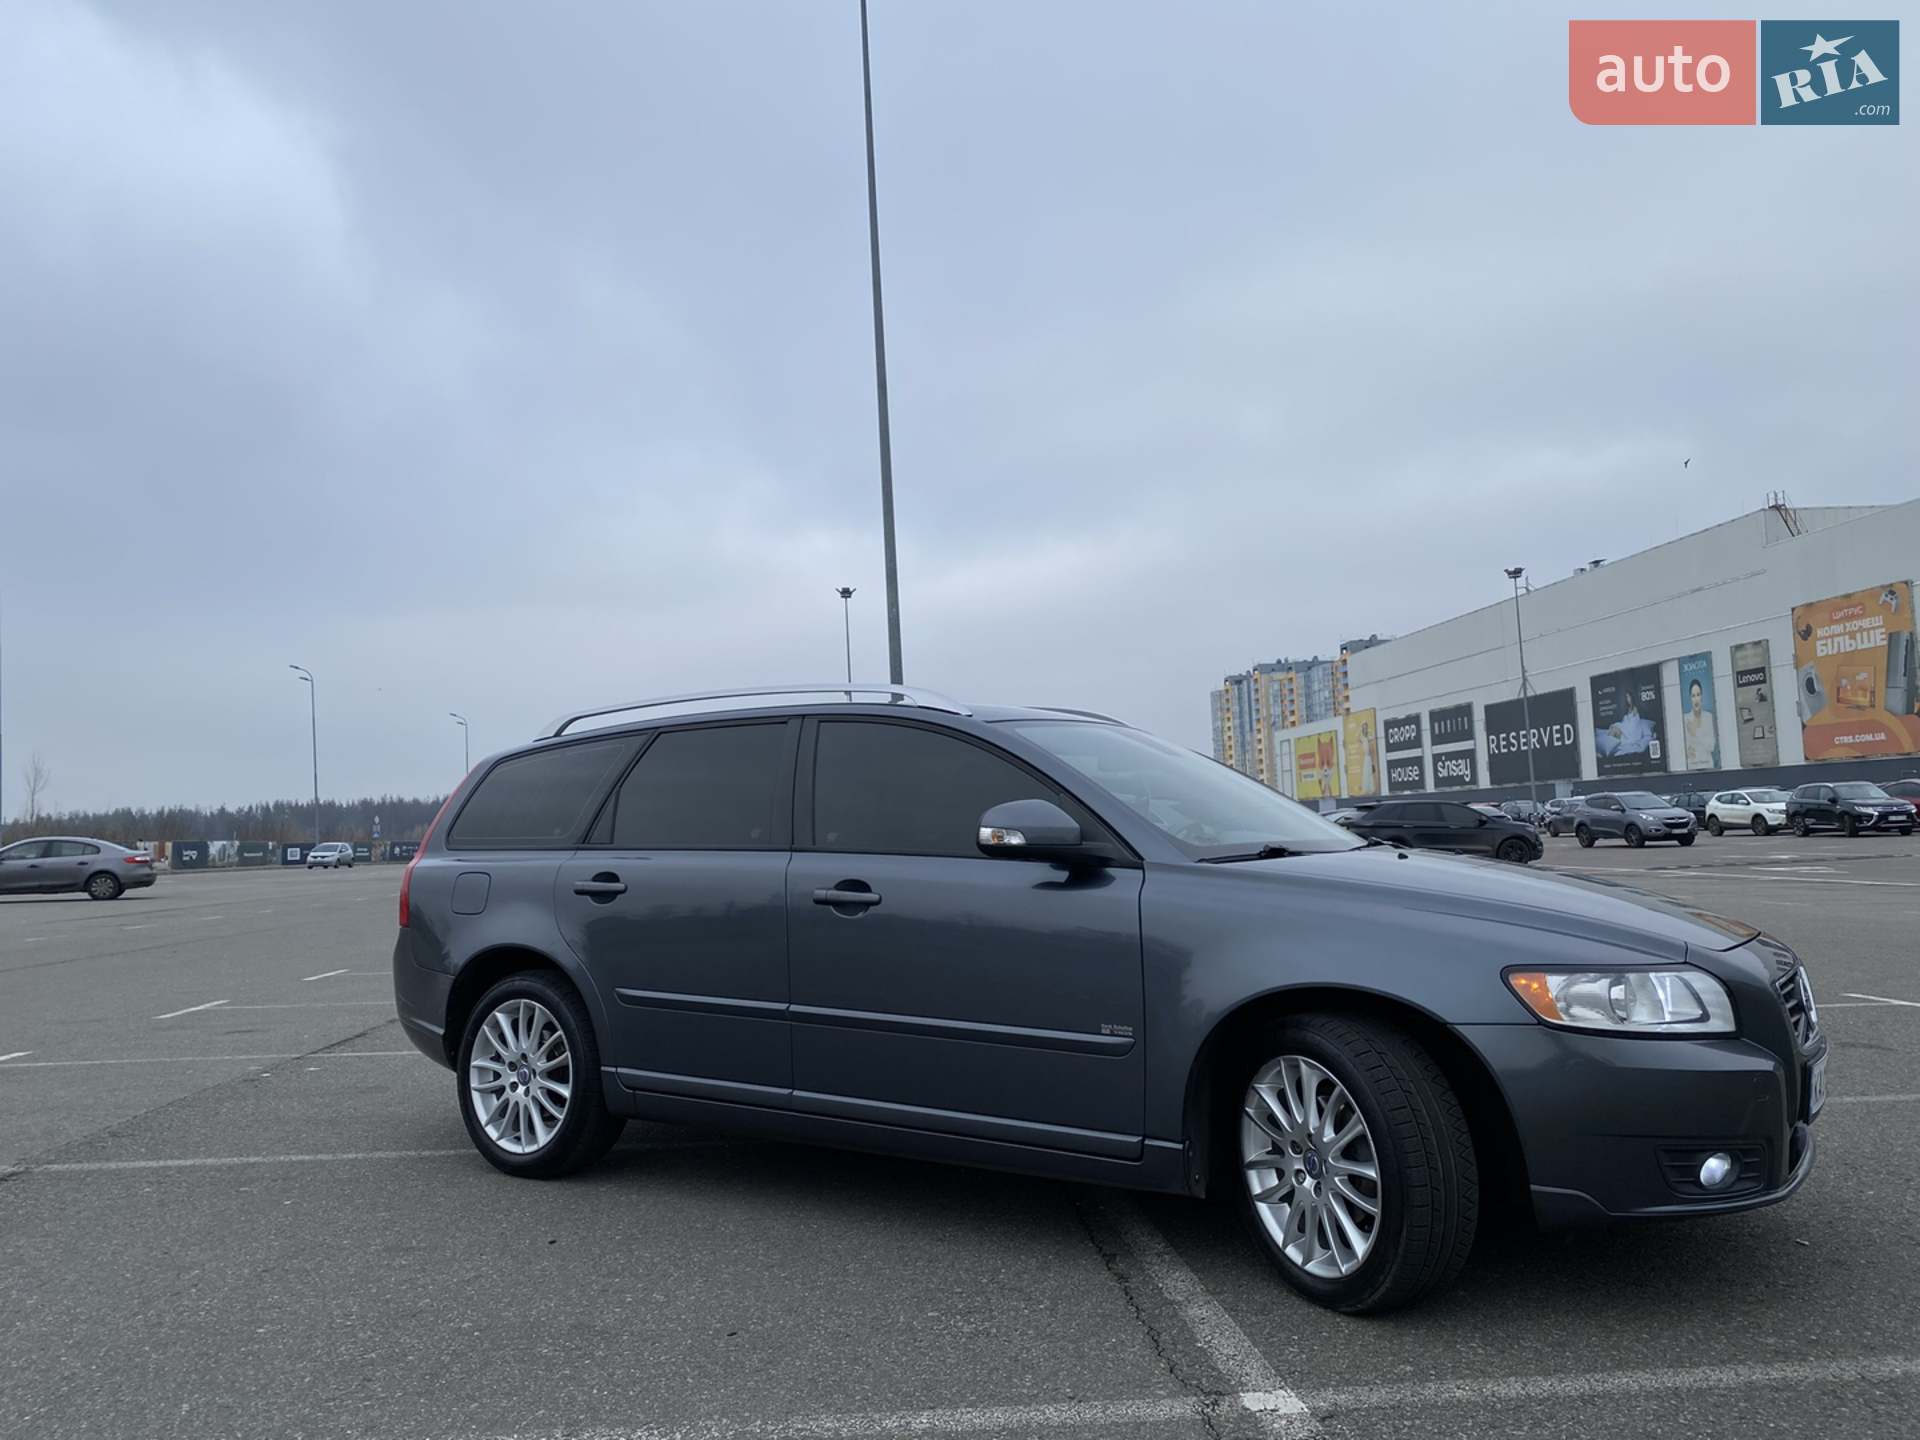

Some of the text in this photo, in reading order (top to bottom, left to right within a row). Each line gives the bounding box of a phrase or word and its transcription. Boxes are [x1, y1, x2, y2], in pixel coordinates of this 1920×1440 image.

[1832, 606, 1863, 620] ЦИТРУС
[1816, 615, 1884, 638] КОЛИ ХОЧЕШ
[1815, 628, 1887, 657] БІЛЬШЕ
[1738, 672, 1765, 684] Lenovo
[1388, 724, 1417, 743] CROPP
[1489, 723, 1575, 755] RESERVED
[1437, 756, 1471, 782] sinsay
